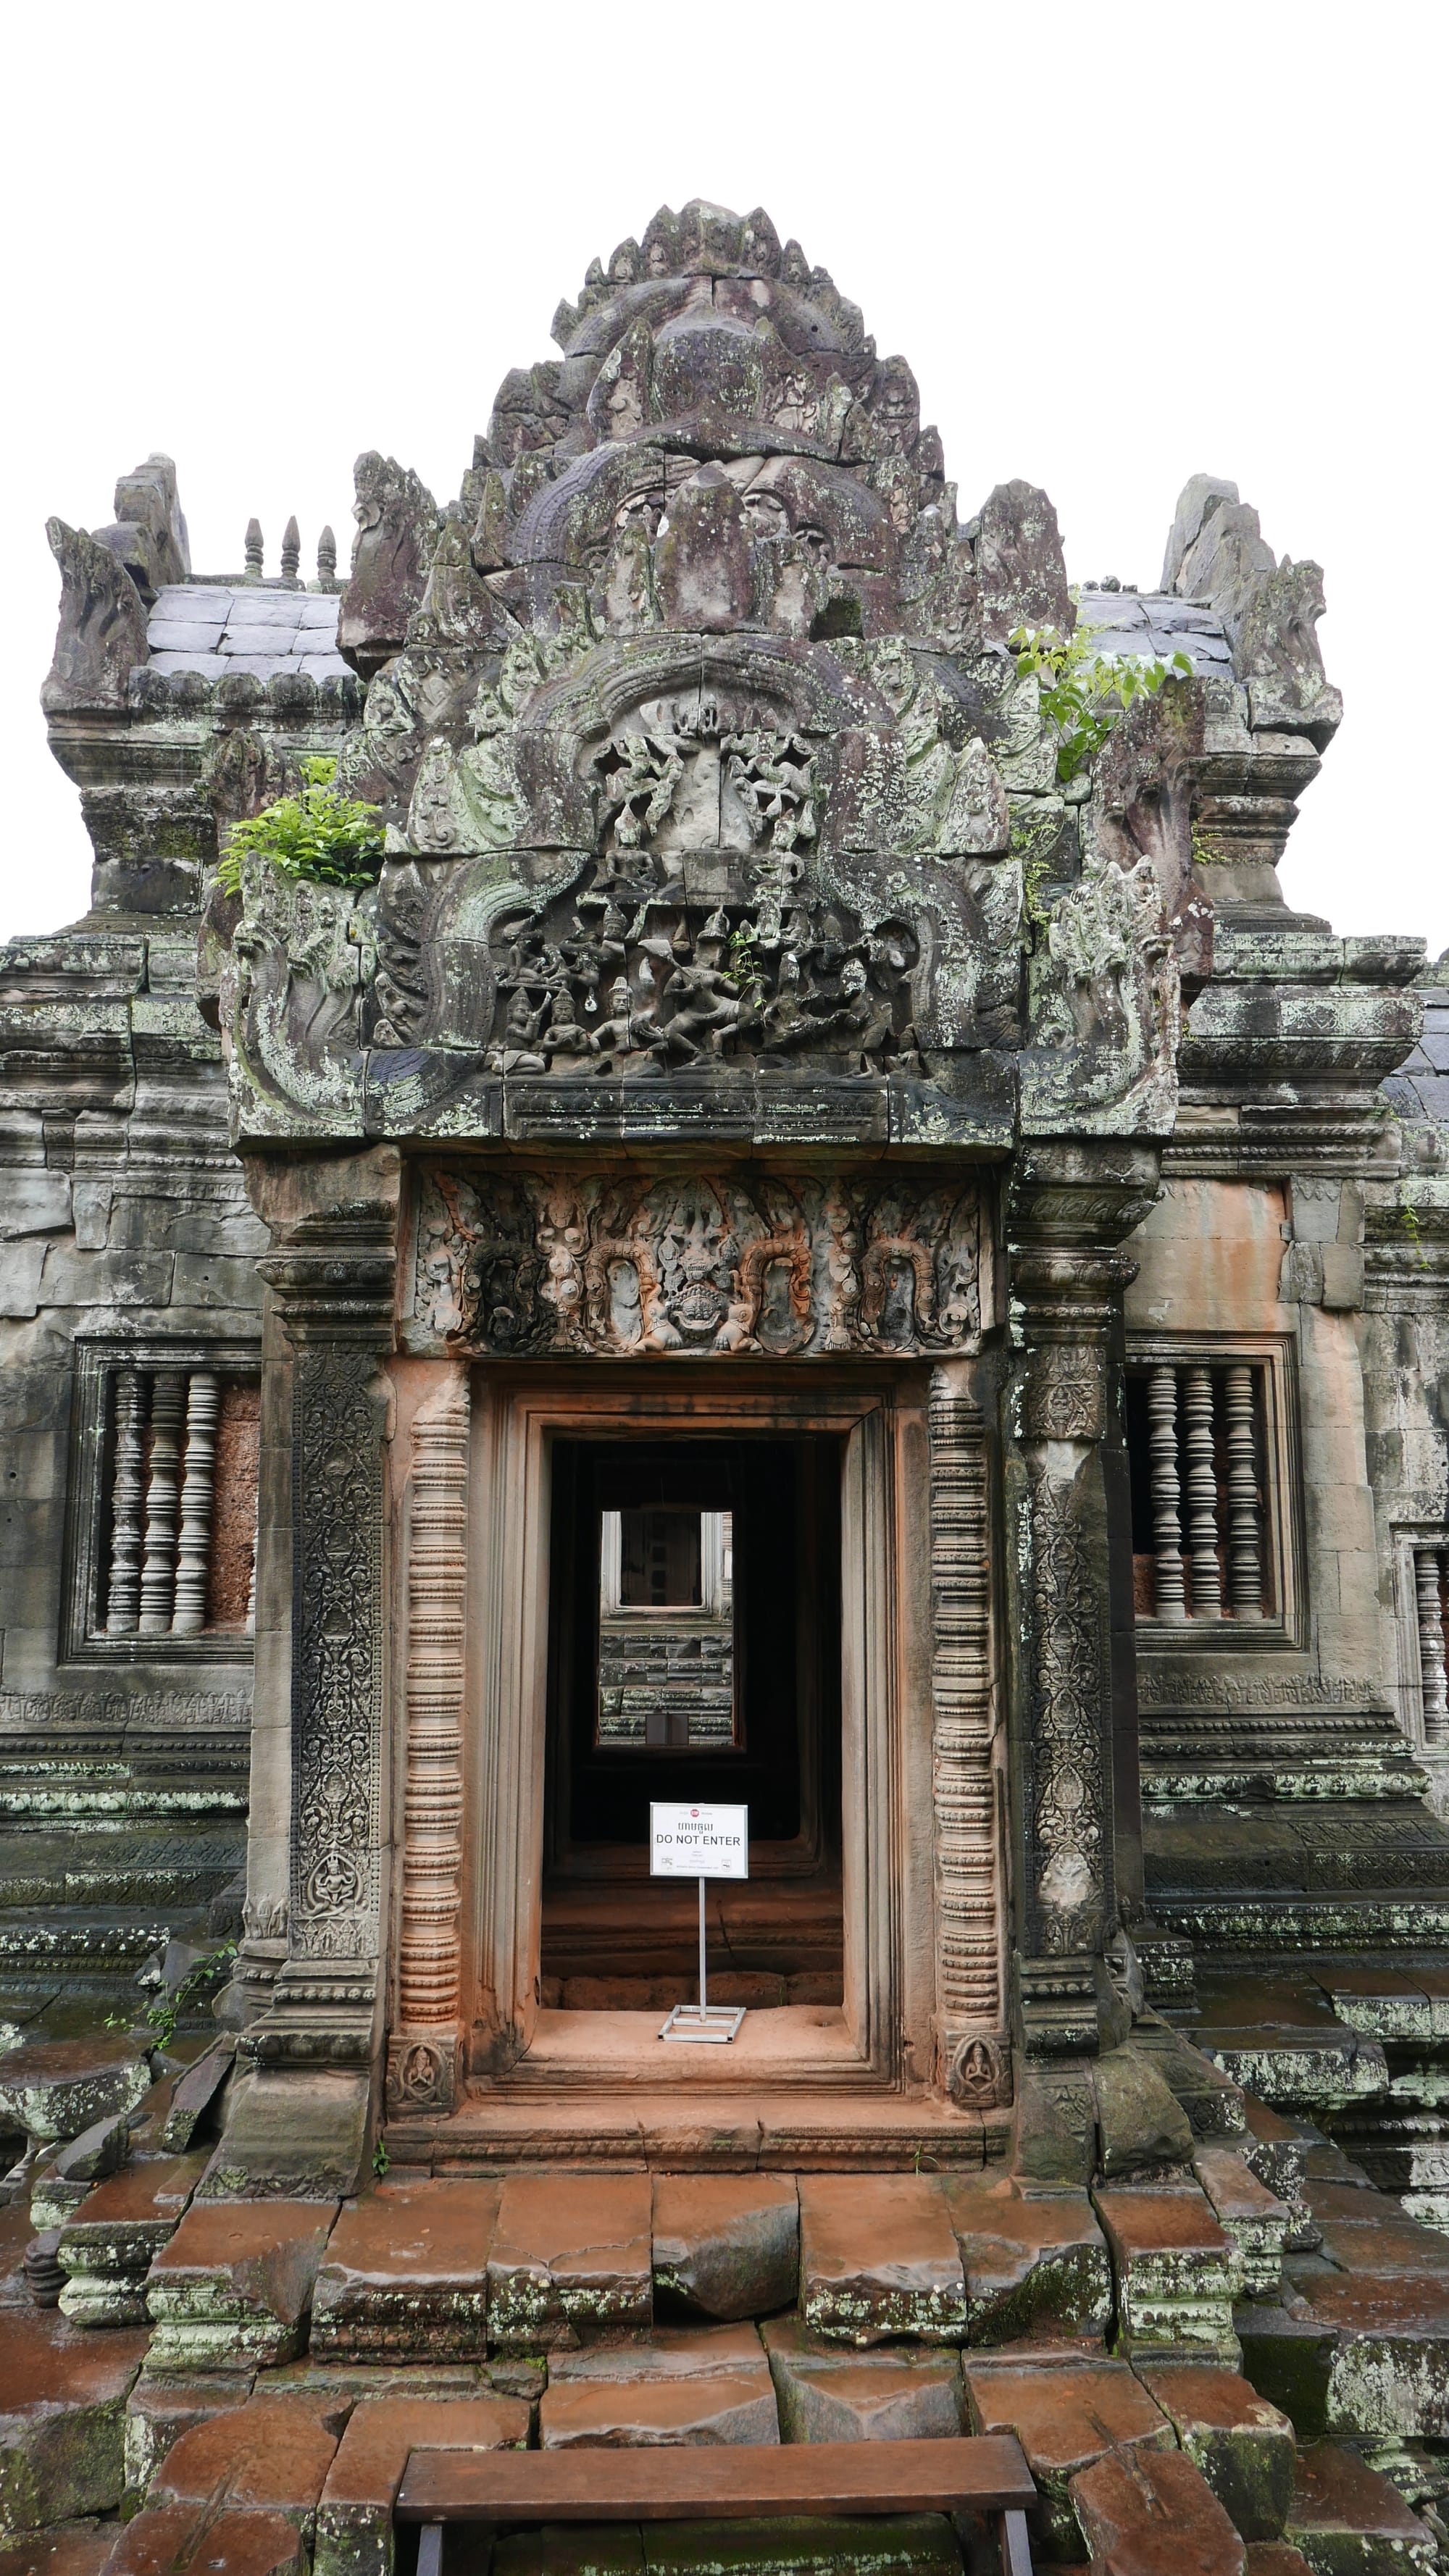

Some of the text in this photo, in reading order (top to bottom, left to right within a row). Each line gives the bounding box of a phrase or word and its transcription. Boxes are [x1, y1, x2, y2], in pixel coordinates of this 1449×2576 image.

[656, 1834, 740, 1846] DO NOT ENTER
